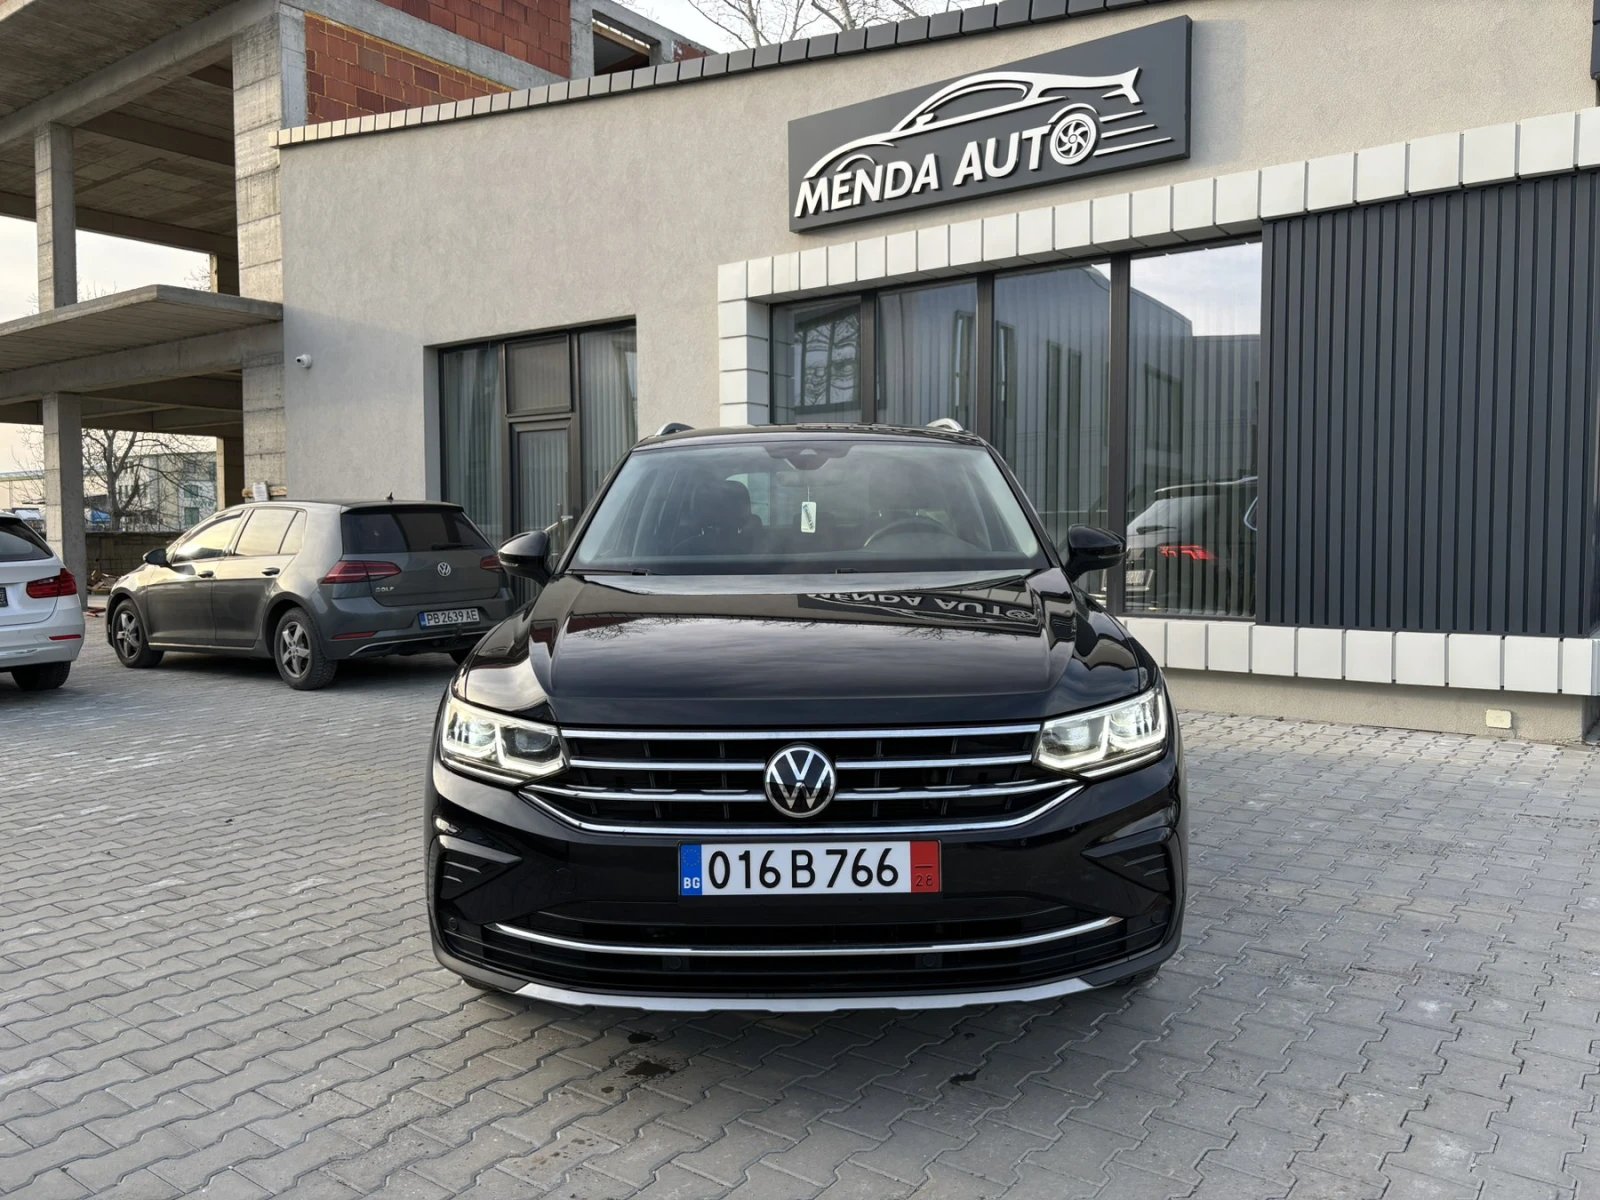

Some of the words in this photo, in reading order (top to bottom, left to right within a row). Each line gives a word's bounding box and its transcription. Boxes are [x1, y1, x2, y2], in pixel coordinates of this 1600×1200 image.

[794, 153, 940, 218] MENDA
[953, 112, 1098, 187] AUTO
[441, 610, 464, 623] 2639
[466, 609, 478, 621] AE
[683, 876, 701, 889] BG
